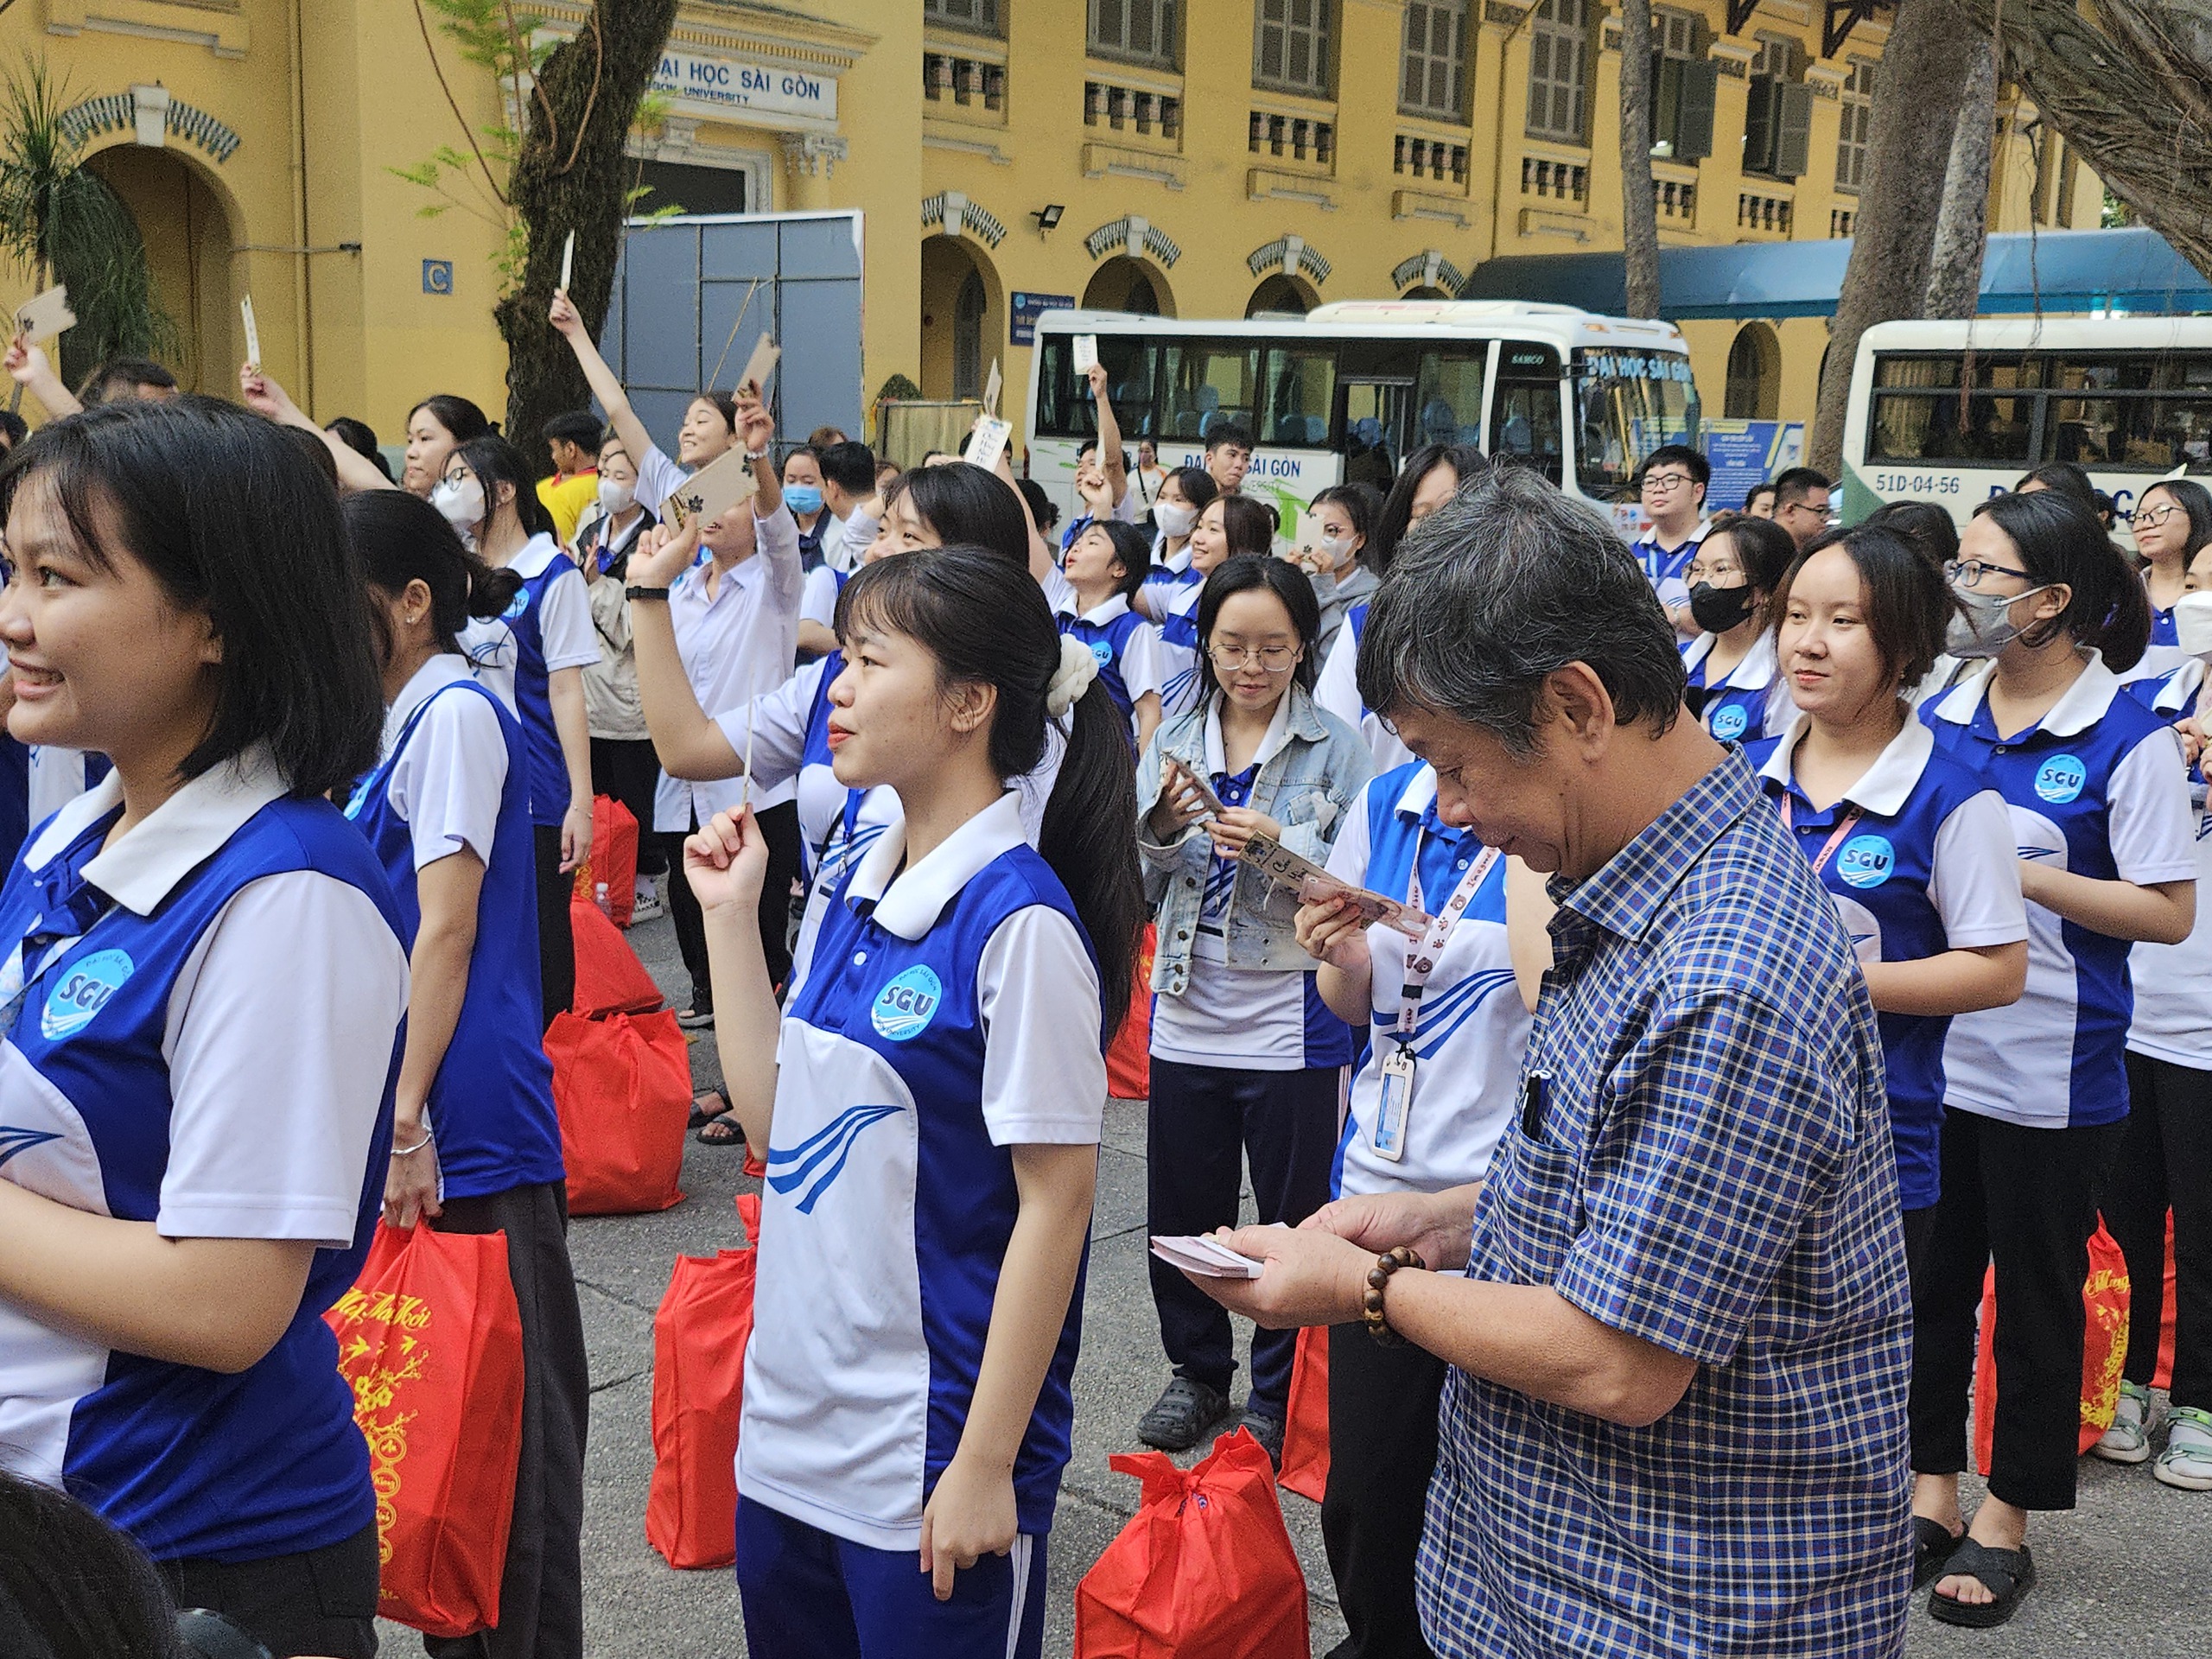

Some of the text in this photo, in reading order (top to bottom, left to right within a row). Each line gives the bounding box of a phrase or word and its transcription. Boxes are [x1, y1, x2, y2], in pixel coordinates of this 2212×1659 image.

[690, 61, 730, 88] HỌC
[741, 69, 771, 92] SÀI
[781, 75, 821, 100] GÒN
[683, 86, 750, 105] UNIVERSITY
[428, 264, 448, 291] C
[1270, 455, 1301, 478] GÒN
[1717, 714, 1743, 728] SGU
[2041, 767, 2082, 789] SGU
[1843, 848, 1890, 872] SGU
[881, 985, 935, 1017] SGU
